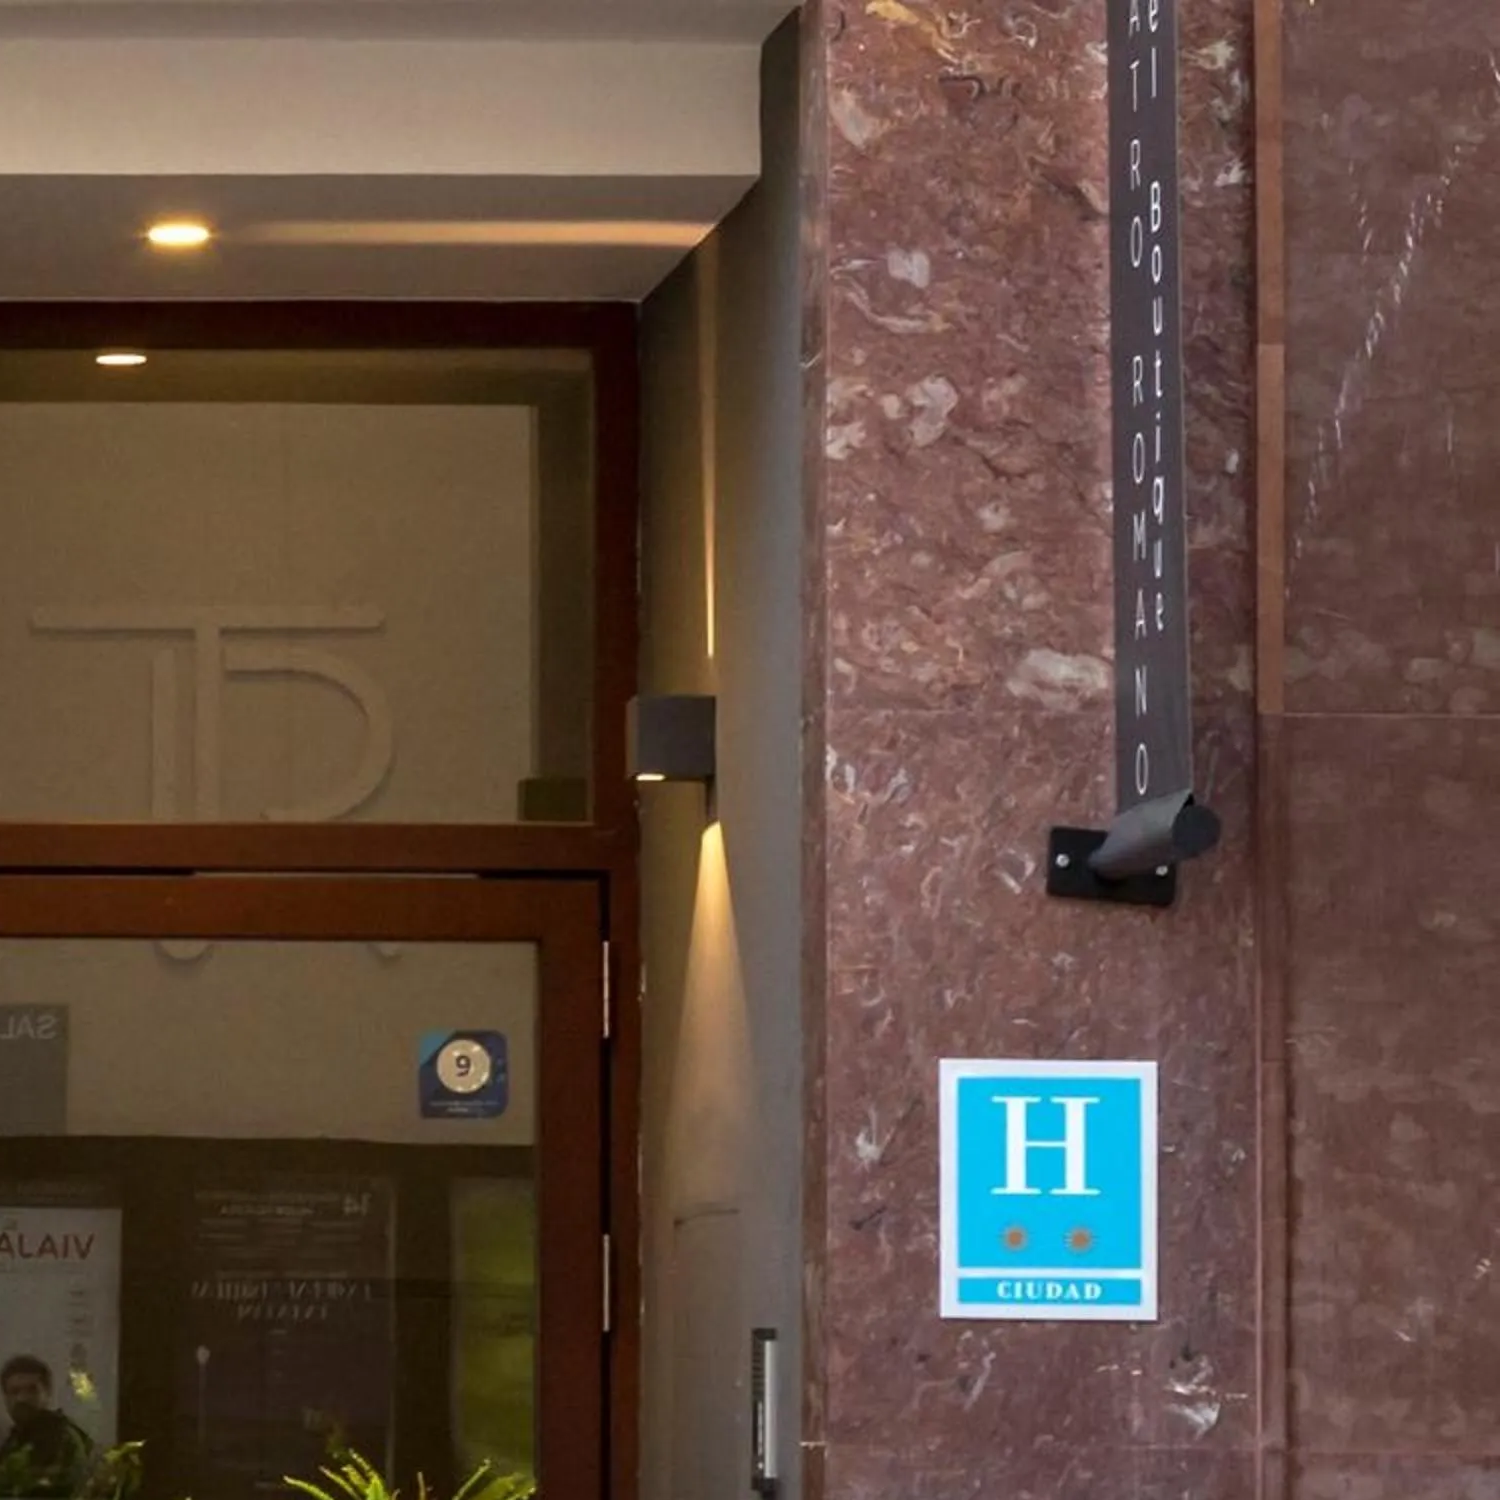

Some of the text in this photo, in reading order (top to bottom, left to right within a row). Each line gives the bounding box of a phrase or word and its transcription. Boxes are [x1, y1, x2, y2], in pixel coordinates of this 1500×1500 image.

[1131, 355, 1149, 796] ROMANO
[990, 1095, 1102, 1197] H
[996, 1281, 1102, 1300] CIUDAD
